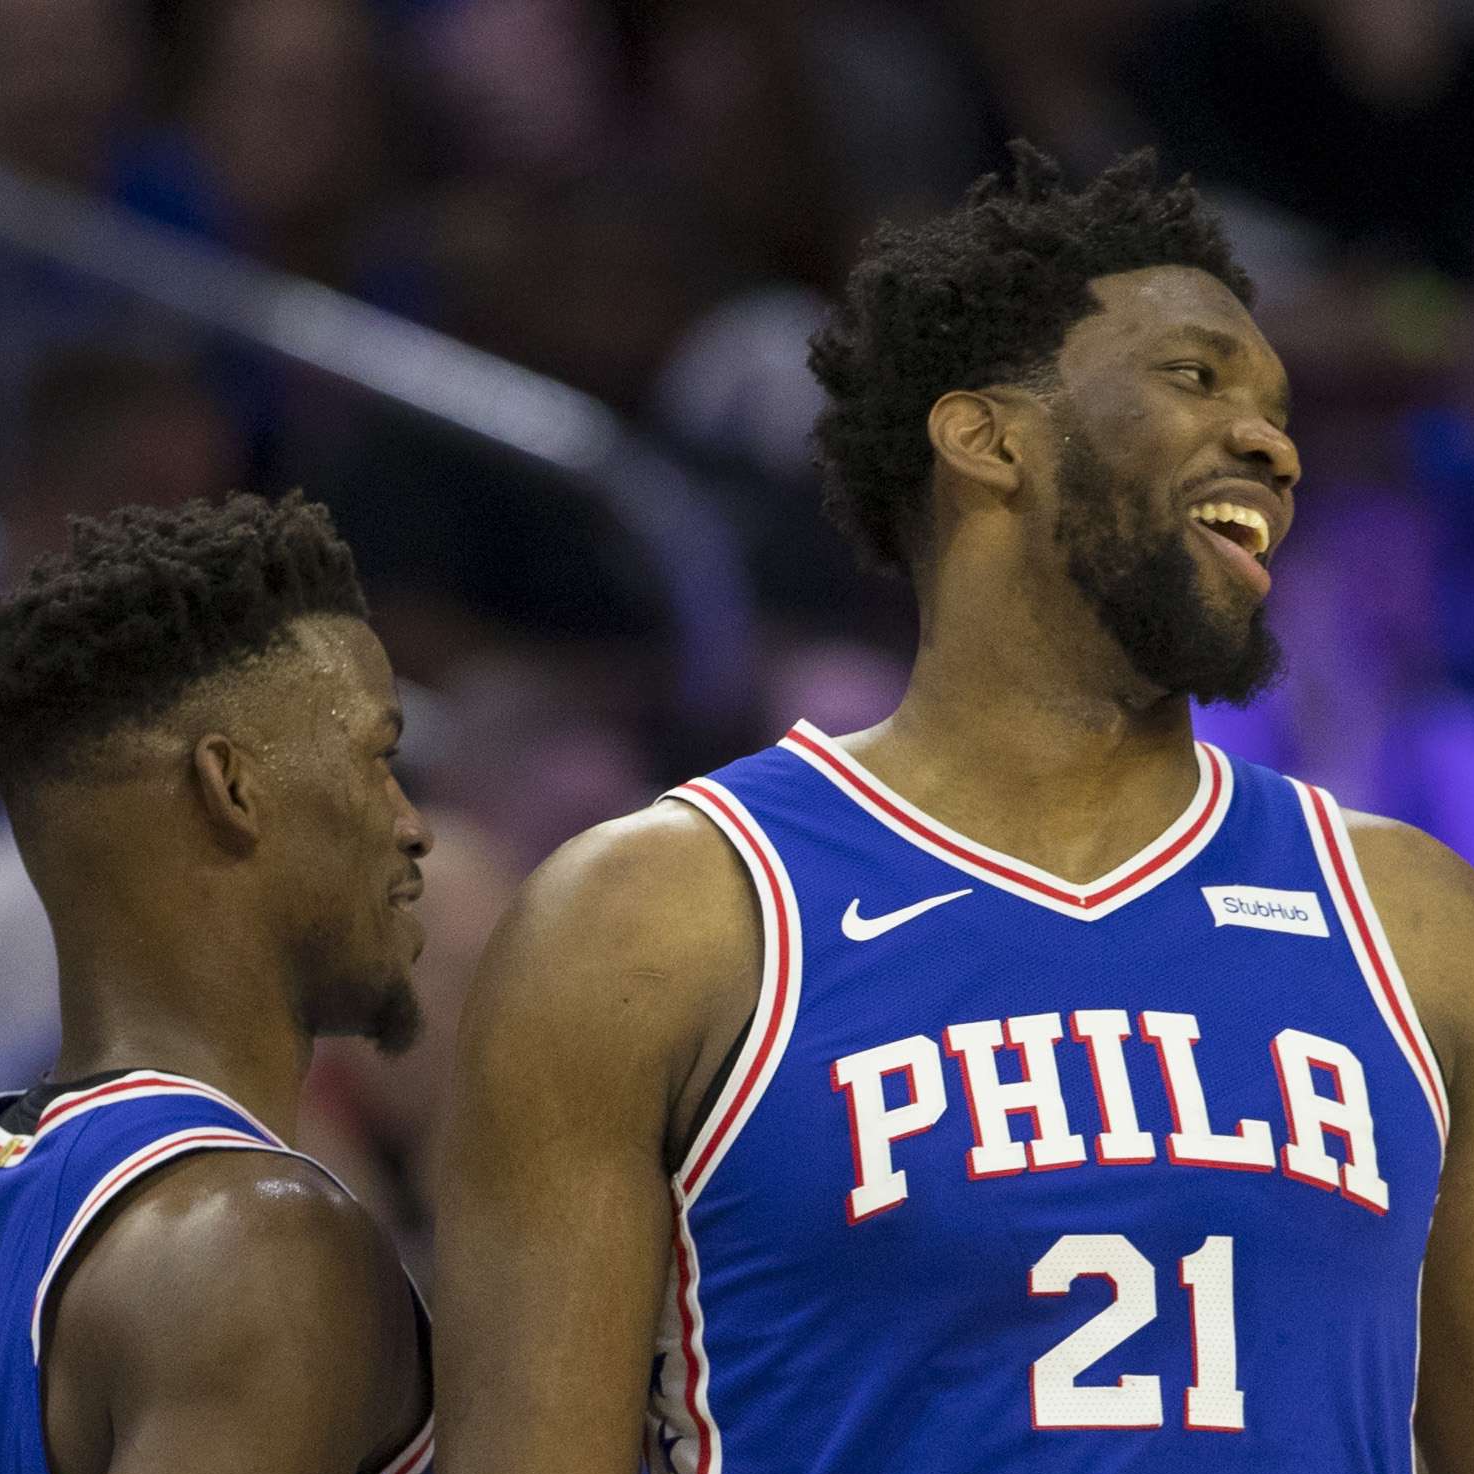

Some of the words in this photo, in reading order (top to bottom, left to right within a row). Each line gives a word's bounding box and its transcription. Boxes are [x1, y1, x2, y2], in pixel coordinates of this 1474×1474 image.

[1222, 896, 1309, 922] StubHub
[830, 1008, 1390, 1227] PHILA
[1027, 1233, 1246, 1432] 21
